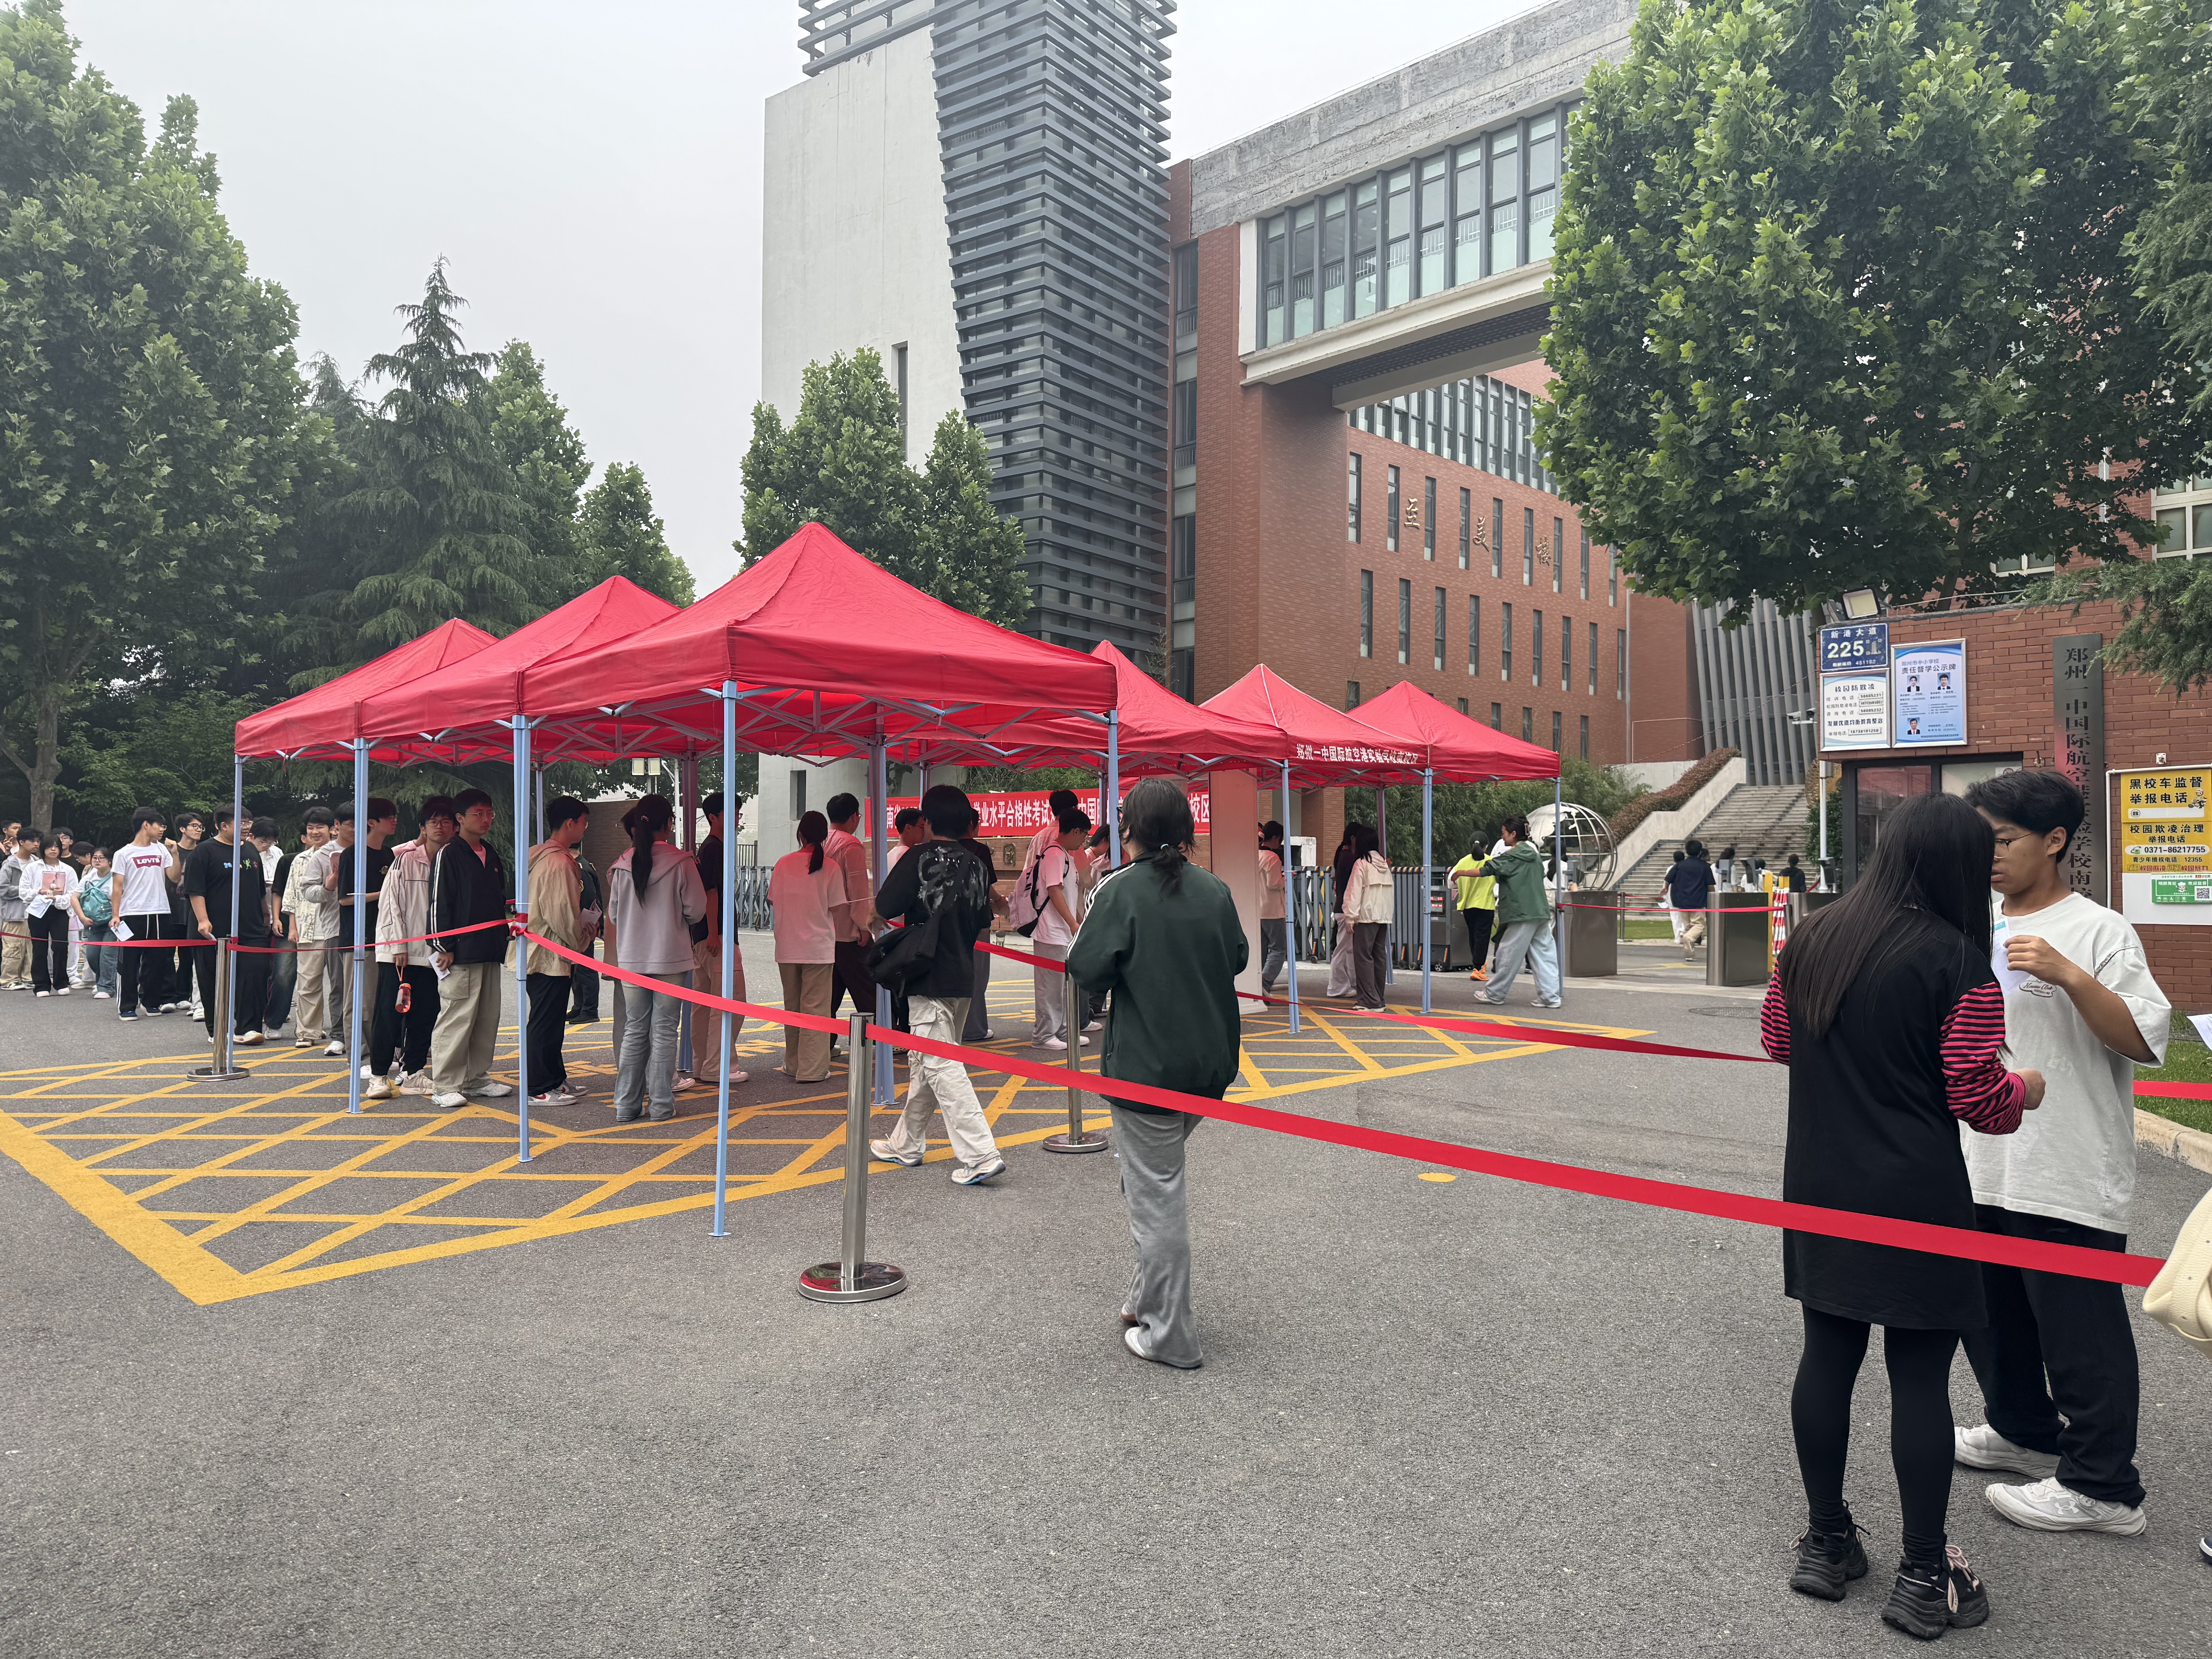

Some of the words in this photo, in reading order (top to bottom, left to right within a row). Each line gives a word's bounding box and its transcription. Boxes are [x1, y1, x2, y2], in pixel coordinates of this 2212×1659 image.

[1831, 627, 1877, 639] 新港大道
[1827, 640, 1864, 658] 225
[1902, 663, 1956, 674] 责任督学公示牌
[2130, 776, 2202, 789] 黑校车监督
[2130, 792, 2188, 804] 举报电话
[2130, 824, 2204, 833] 校园欺凌治理
